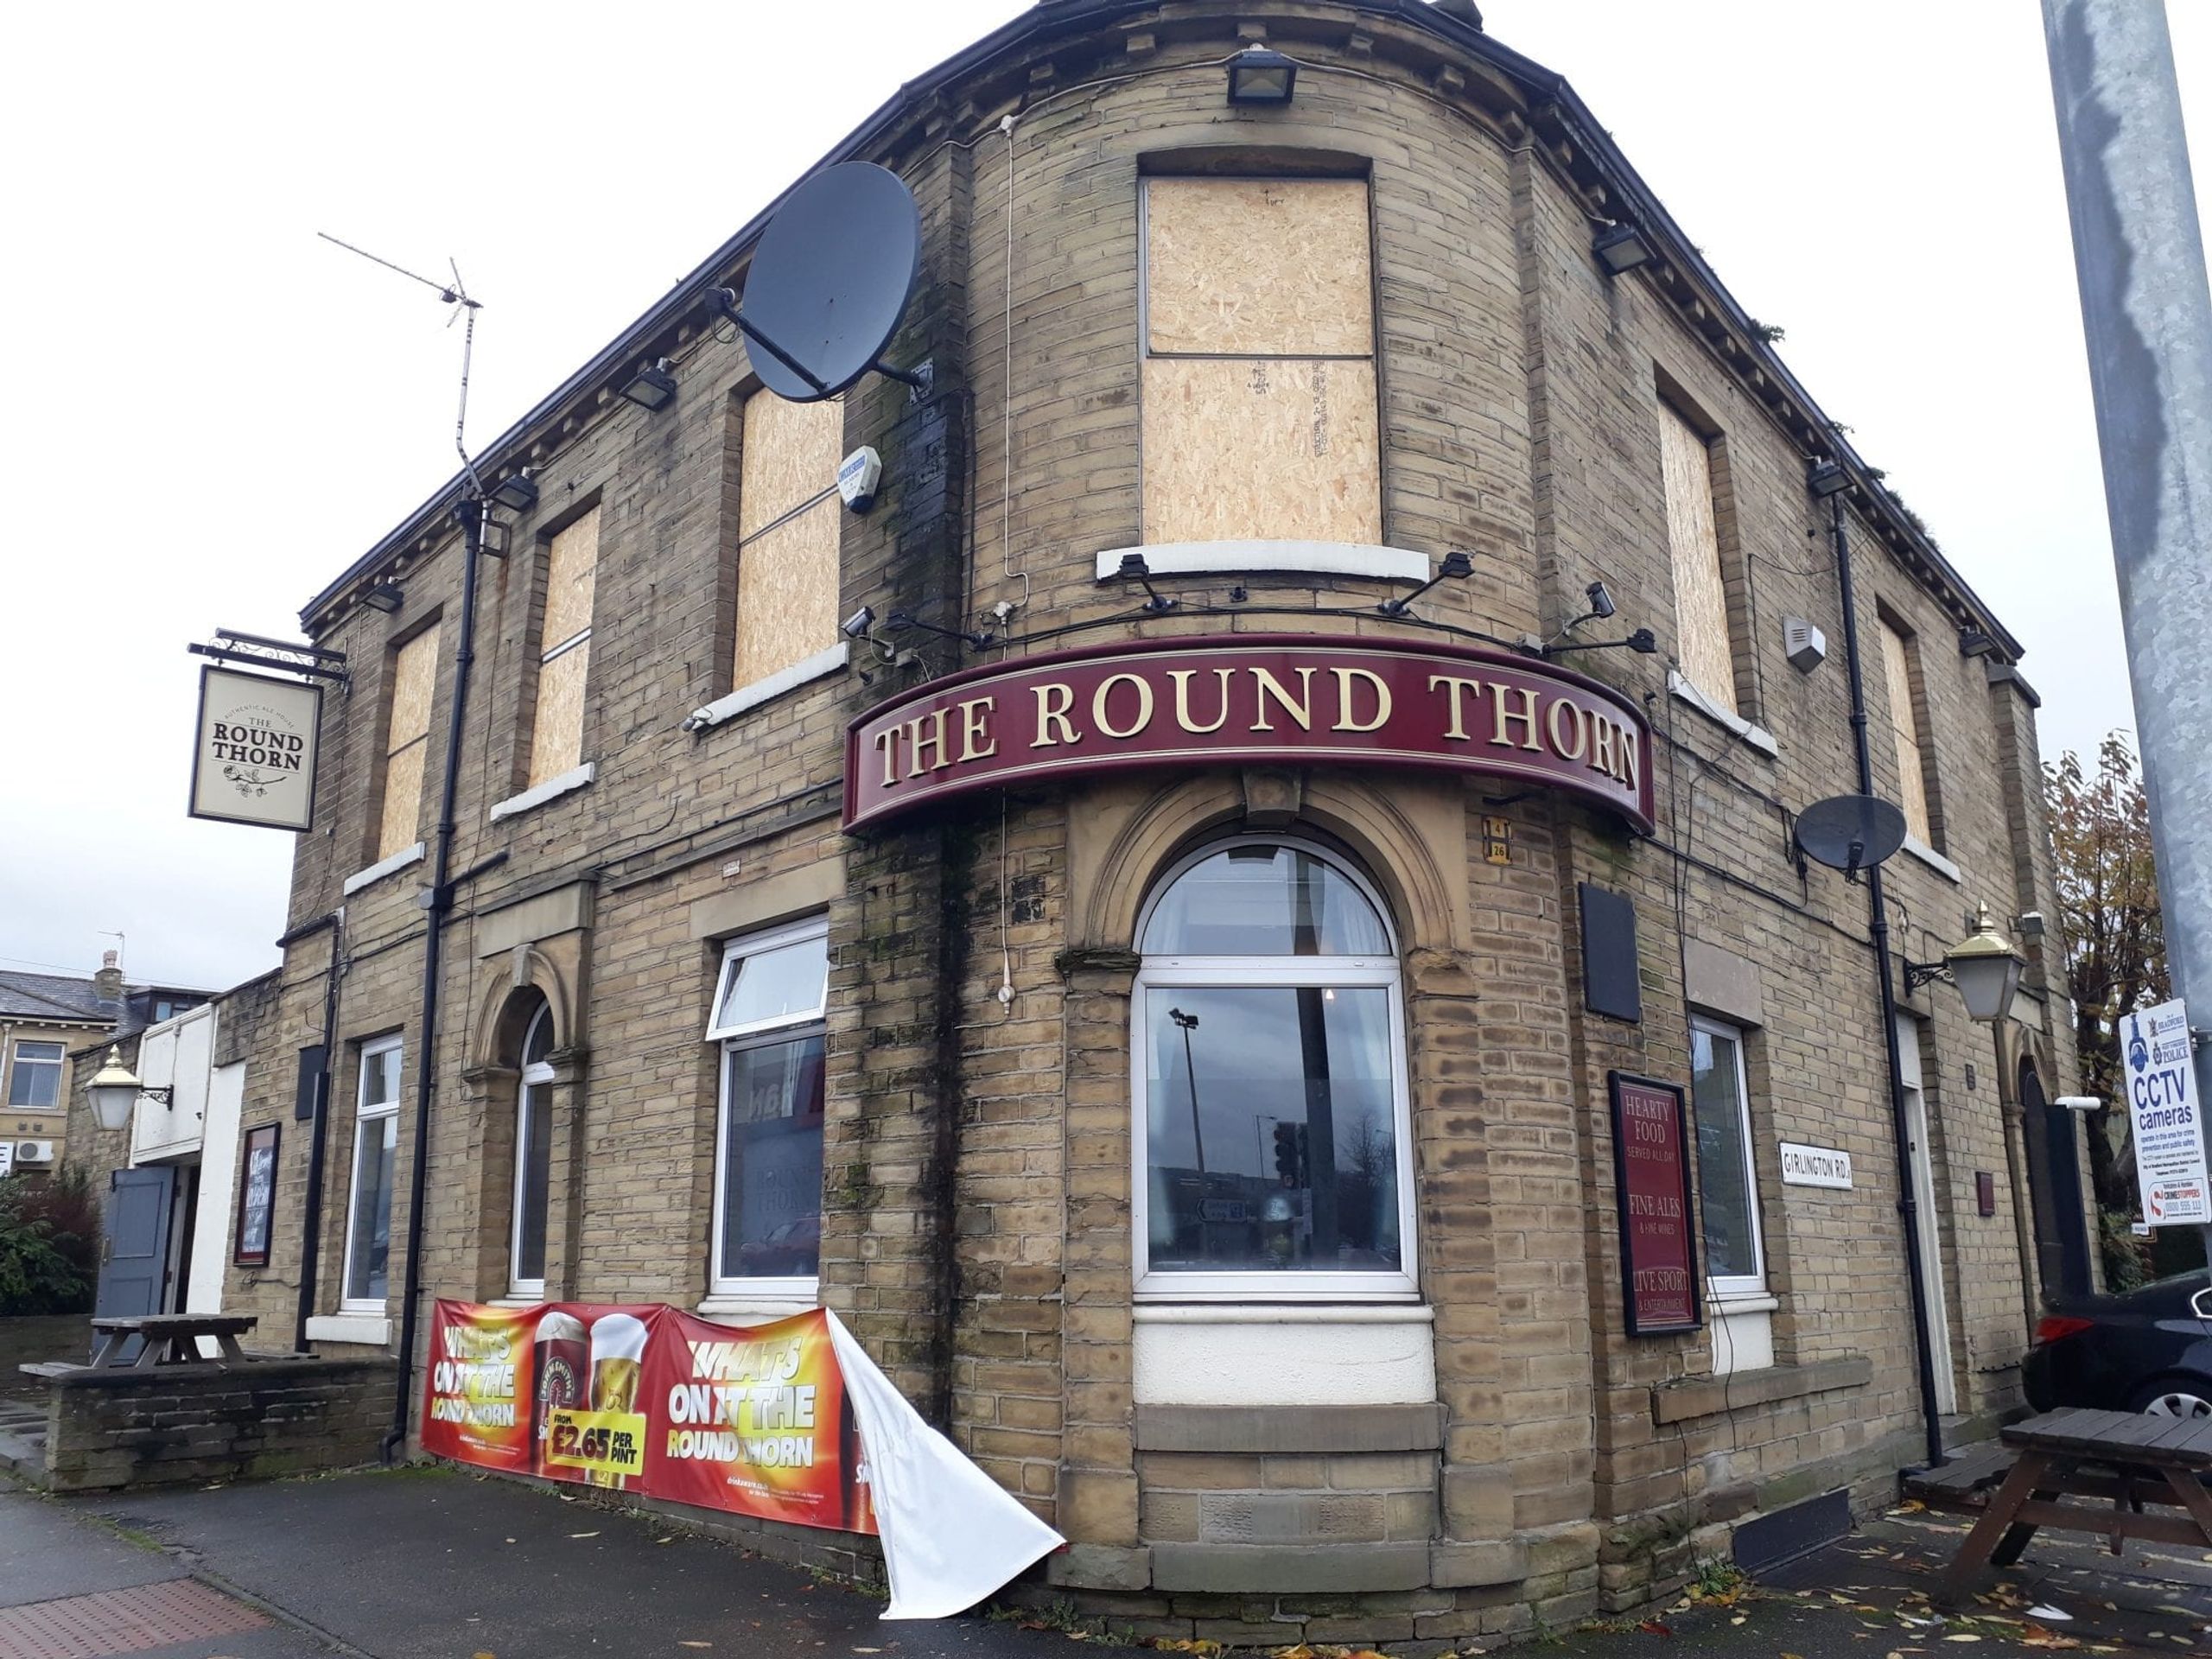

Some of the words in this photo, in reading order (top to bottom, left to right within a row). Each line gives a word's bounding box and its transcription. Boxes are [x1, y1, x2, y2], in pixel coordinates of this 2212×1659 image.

[248, 717, 272, 728] THE
[874, 696, 997, 788] THE
[1029, 666, 1393, 748] ROUND
[1428, 674, 1639, 791] THORN
[213, 722, 303, 752] ROUND
[212, 742, 302, 771] THORN
[1495, 824, 1501, 835] 4
[2163, 1046, 2189, 1062] POLICE
[2133, 1067, 2185, 1109] CCTV
[1624, 1095, 1669, 1122] HEARTY
[2139, 1105, 2193, 1130] cameras
[1635, 1121, 1666, 1144] FOOD
[1626, 1146, 1651, 1160] SERVED
[1652, 1148, 1663, 1161] ALL
[2171, 1141, 2183, 1150] public
[1784, 1153, 1834, 1178] GIRLINGTON
[1629, 1194, 1654, 1217] FINE
[1657, 1197, 1681, 1218] ALES
[1633, 1272, 1656, 1293] LIVE
[1657, 1270, 1688, 1291] SPORT
[1643, 1299, 1686, 1313] ENTERTAINMENT
[688, 1337, 803, 1382] WHAT'S
[434, 1361, 454, 1394] ON
[477, 1363, 516, 1398] THE
[668, 1384, 710, 1425] ON
[713, 1385, 747, 1429] AT
[750, 1384, 816, 1430] THE
[554, 1414, 572, 1425] FROM
[551, 1425, 612, 1462] £2.65
[612, 1430, 632, 1448] PER
[666, 1429, 741, 1462] ROUND
[611, 1445, 638, 1465] PINT
